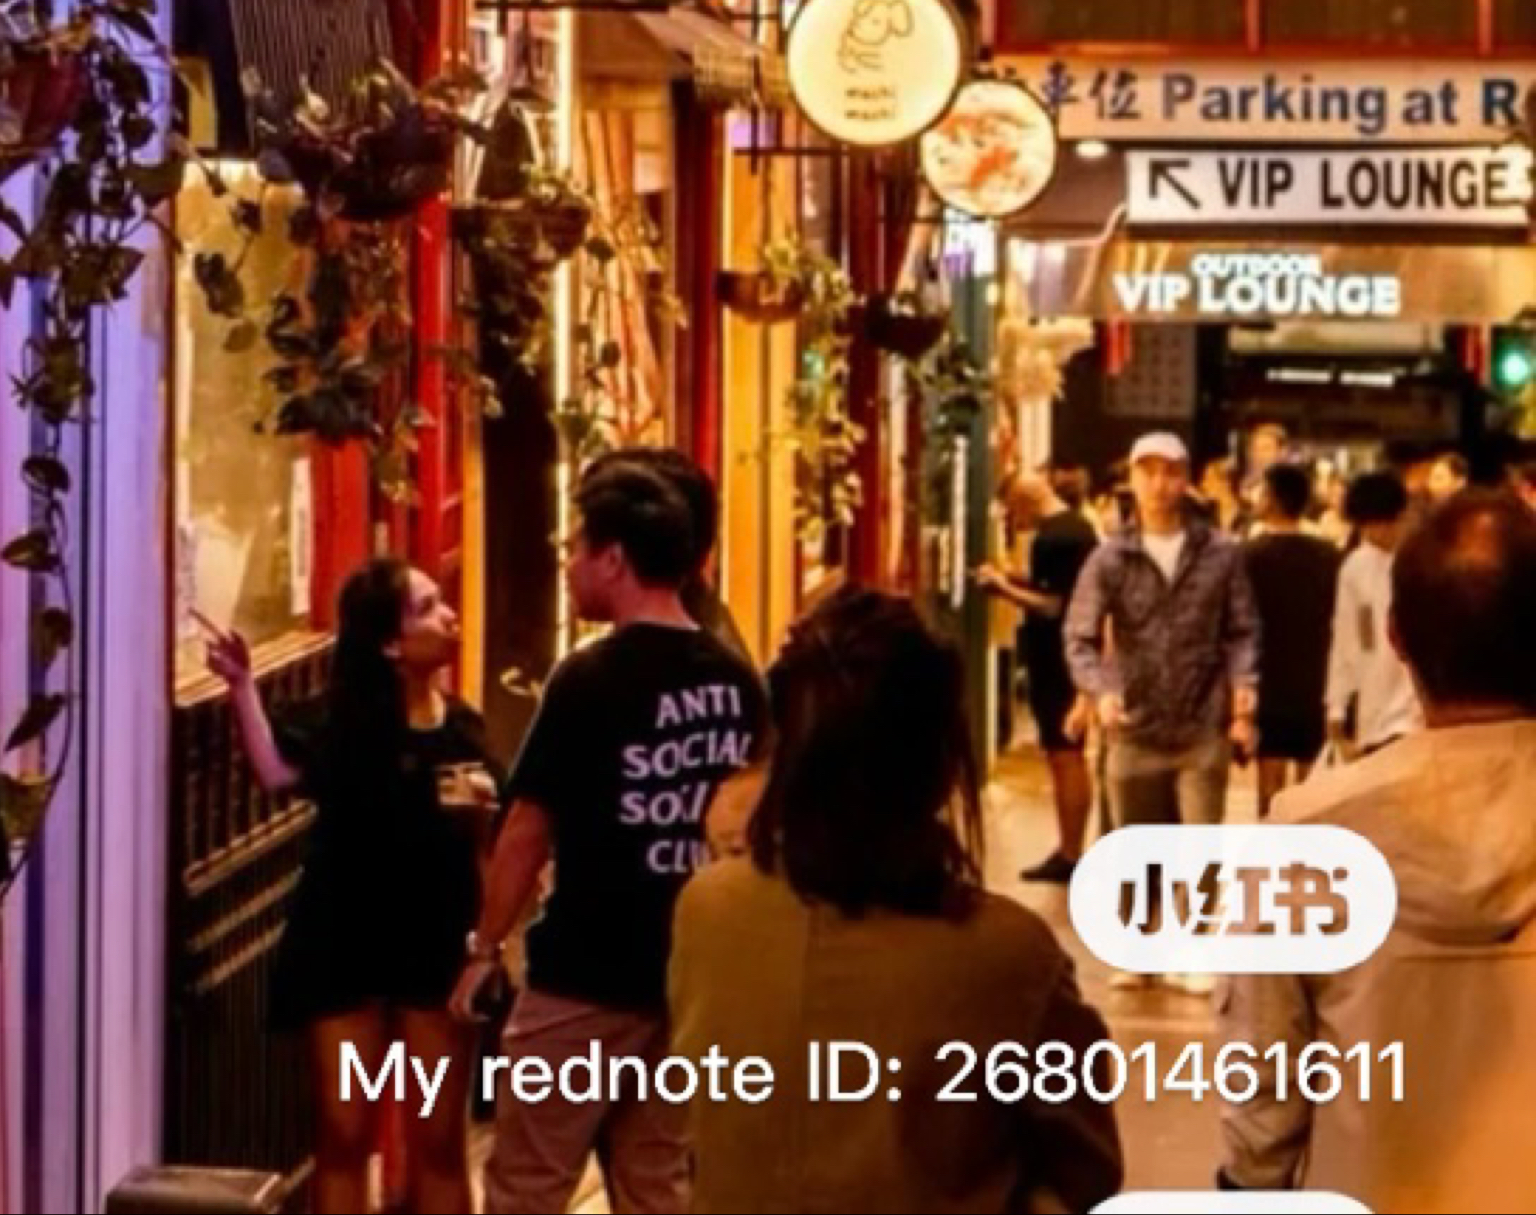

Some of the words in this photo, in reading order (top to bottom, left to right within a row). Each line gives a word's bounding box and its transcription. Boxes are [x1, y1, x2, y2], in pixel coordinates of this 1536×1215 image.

[1162, 72, 1388, 136] Parking
[1402, 79, 1460, 126] at
[1218, 157, 1294, 209] VIP
[1320, 157, 1516, 210] LOUNGE
[1112, 272, 1191, 315] VIP
[1198, 273, 1402, 318] LOUNGE
[654, 683, 742, 730] ANTI
[621, 729, 753, 780] SOCIAL
